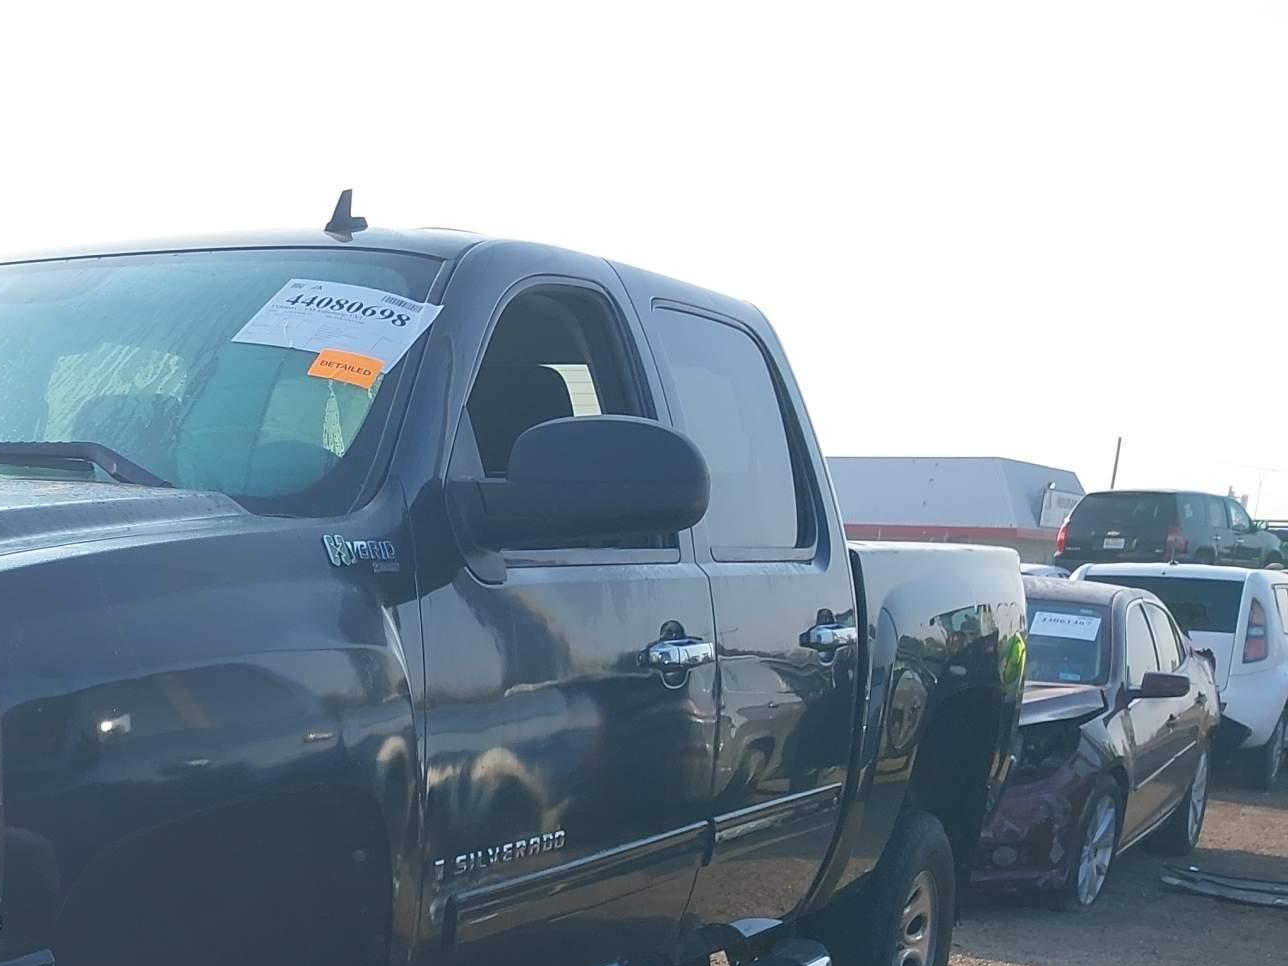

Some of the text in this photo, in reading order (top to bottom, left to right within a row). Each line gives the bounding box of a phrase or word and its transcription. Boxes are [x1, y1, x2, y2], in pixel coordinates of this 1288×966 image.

[285, 294, 411, 327] 44080698
[319, 359, 372, 377] DETAILED
[454, 830, 566, 874] SILVERADO
